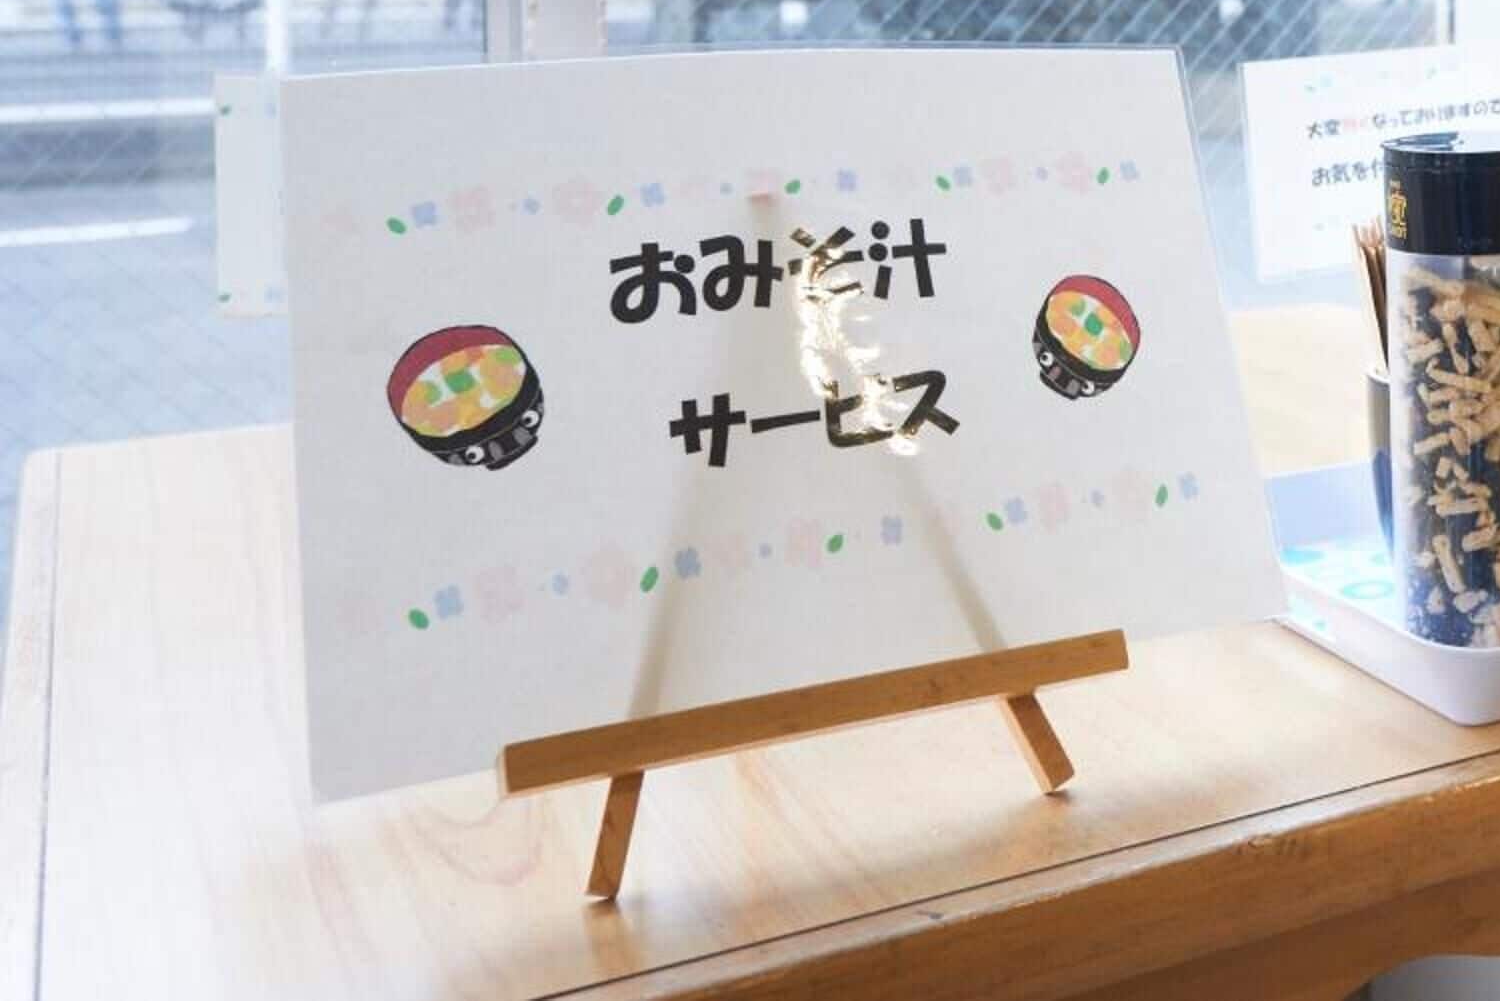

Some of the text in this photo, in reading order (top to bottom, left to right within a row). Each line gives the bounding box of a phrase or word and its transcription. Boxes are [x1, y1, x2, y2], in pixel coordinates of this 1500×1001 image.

[610, 218, 947, 324] おみそ汁
[669, 370, 960, 468] サービス
